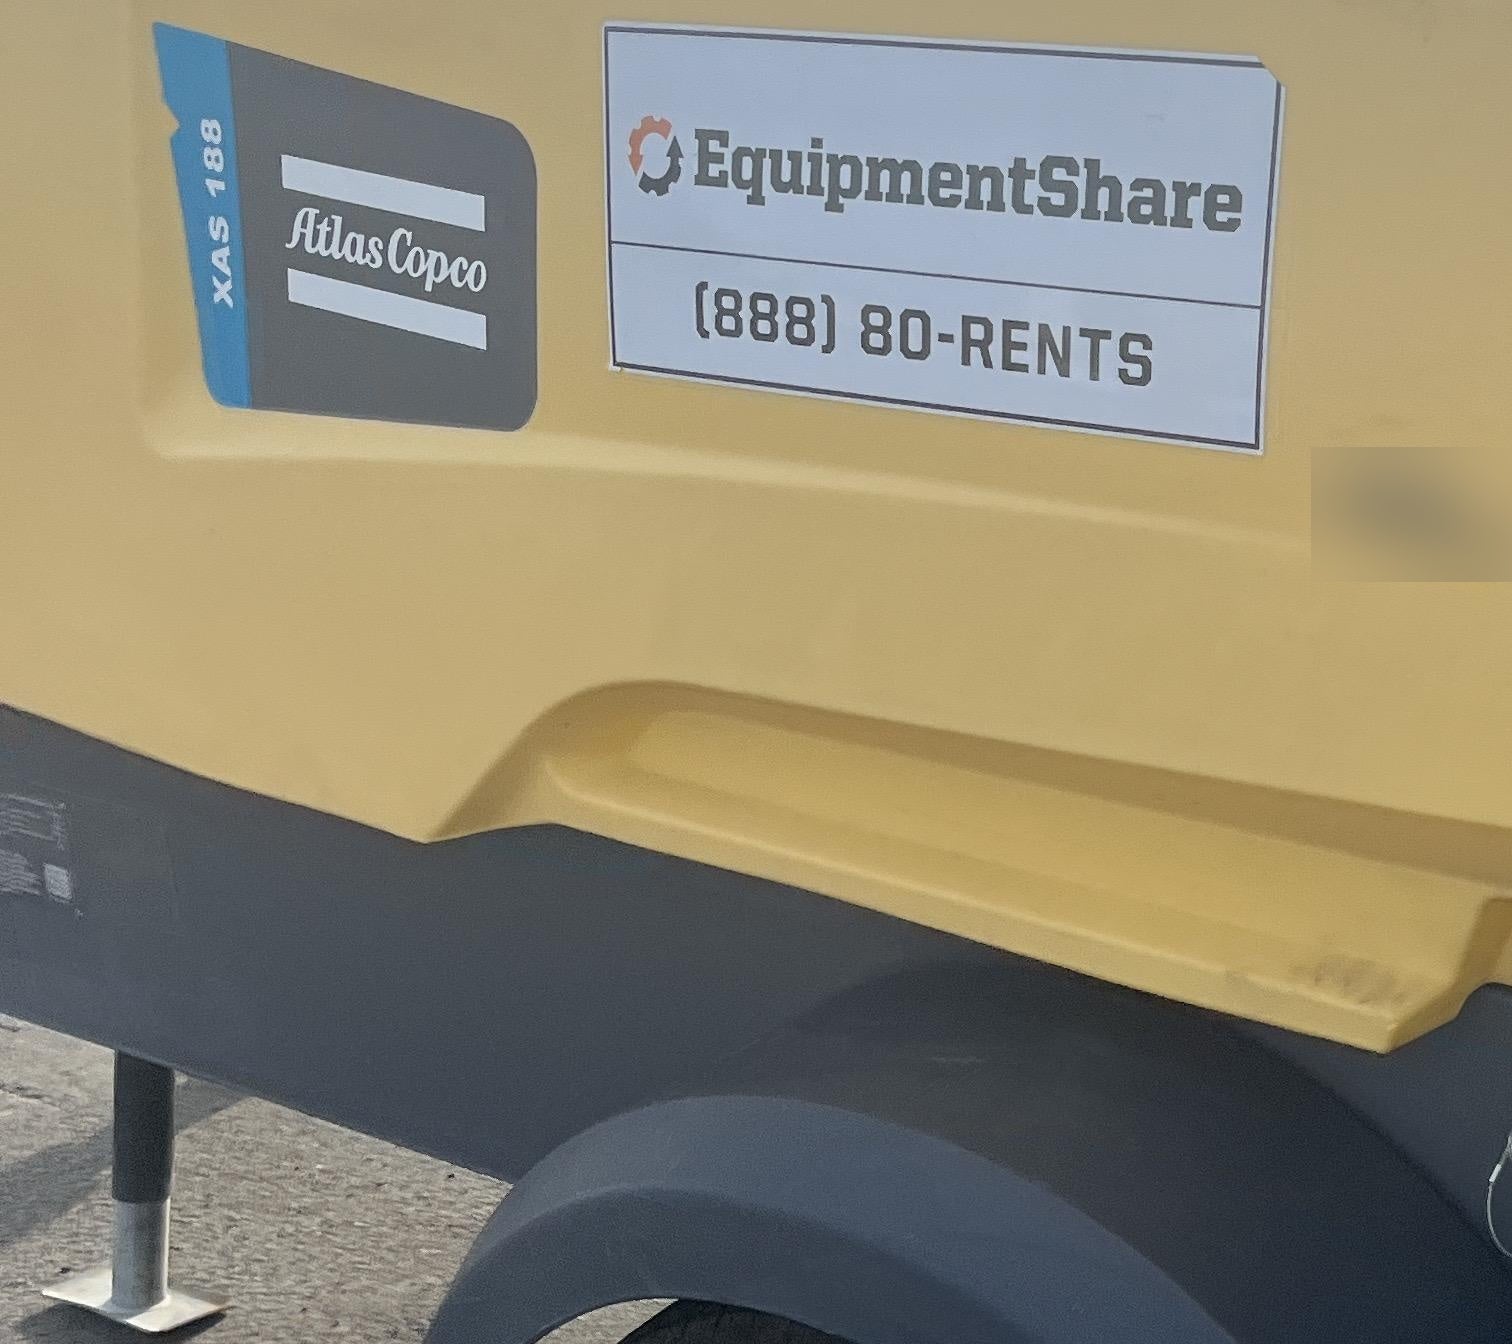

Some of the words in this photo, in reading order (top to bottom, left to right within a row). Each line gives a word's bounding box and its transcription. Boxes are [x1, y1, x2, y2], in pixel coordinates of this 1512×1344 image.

[199, 117, 226, 199] 188
[693, 128, 1243, 233] EquipmentShare
[207, 215, 235, 308] XAS
[695, 280, 836, 355] (888)
[860, 303, 1153, 387] 80-RENTS
